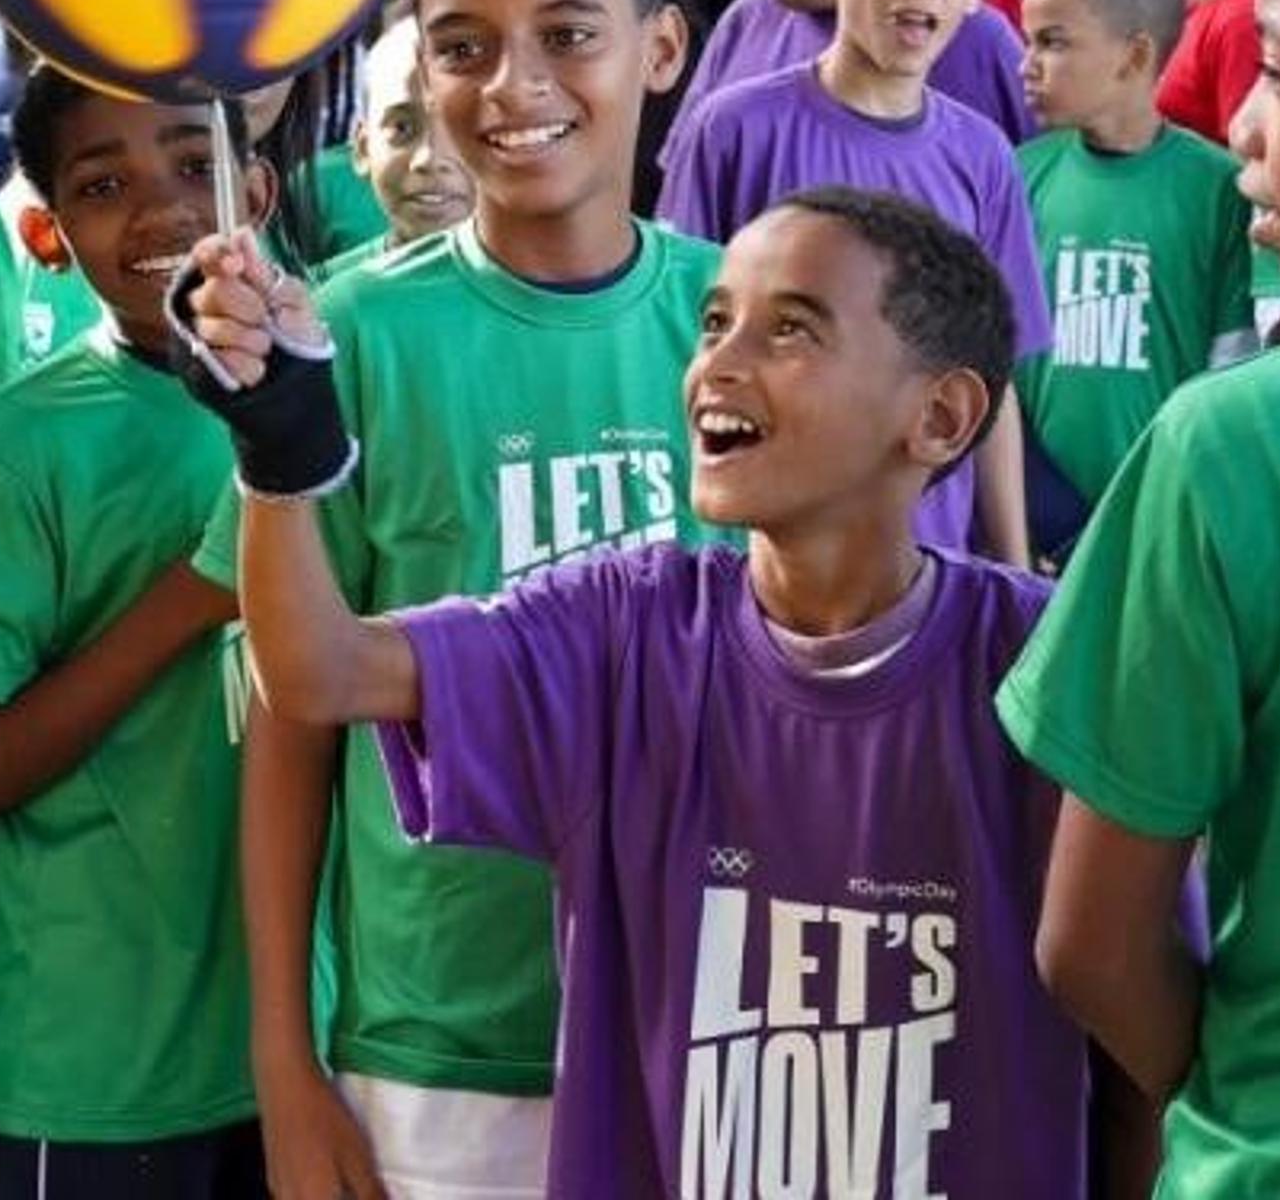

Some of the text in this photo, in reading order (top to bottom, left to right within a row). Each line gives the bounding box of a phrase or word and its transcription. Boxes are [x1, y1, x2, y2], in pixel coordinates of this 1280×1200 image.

[1053, 293, 1151, 371] MOVE
[1055, 249, 1151, 305] LET'S
[498, 450, 676, 576] LET'S
[690, 887, 956, 1041] LET'S
[679, 1011, 956, 1200] MOVE
